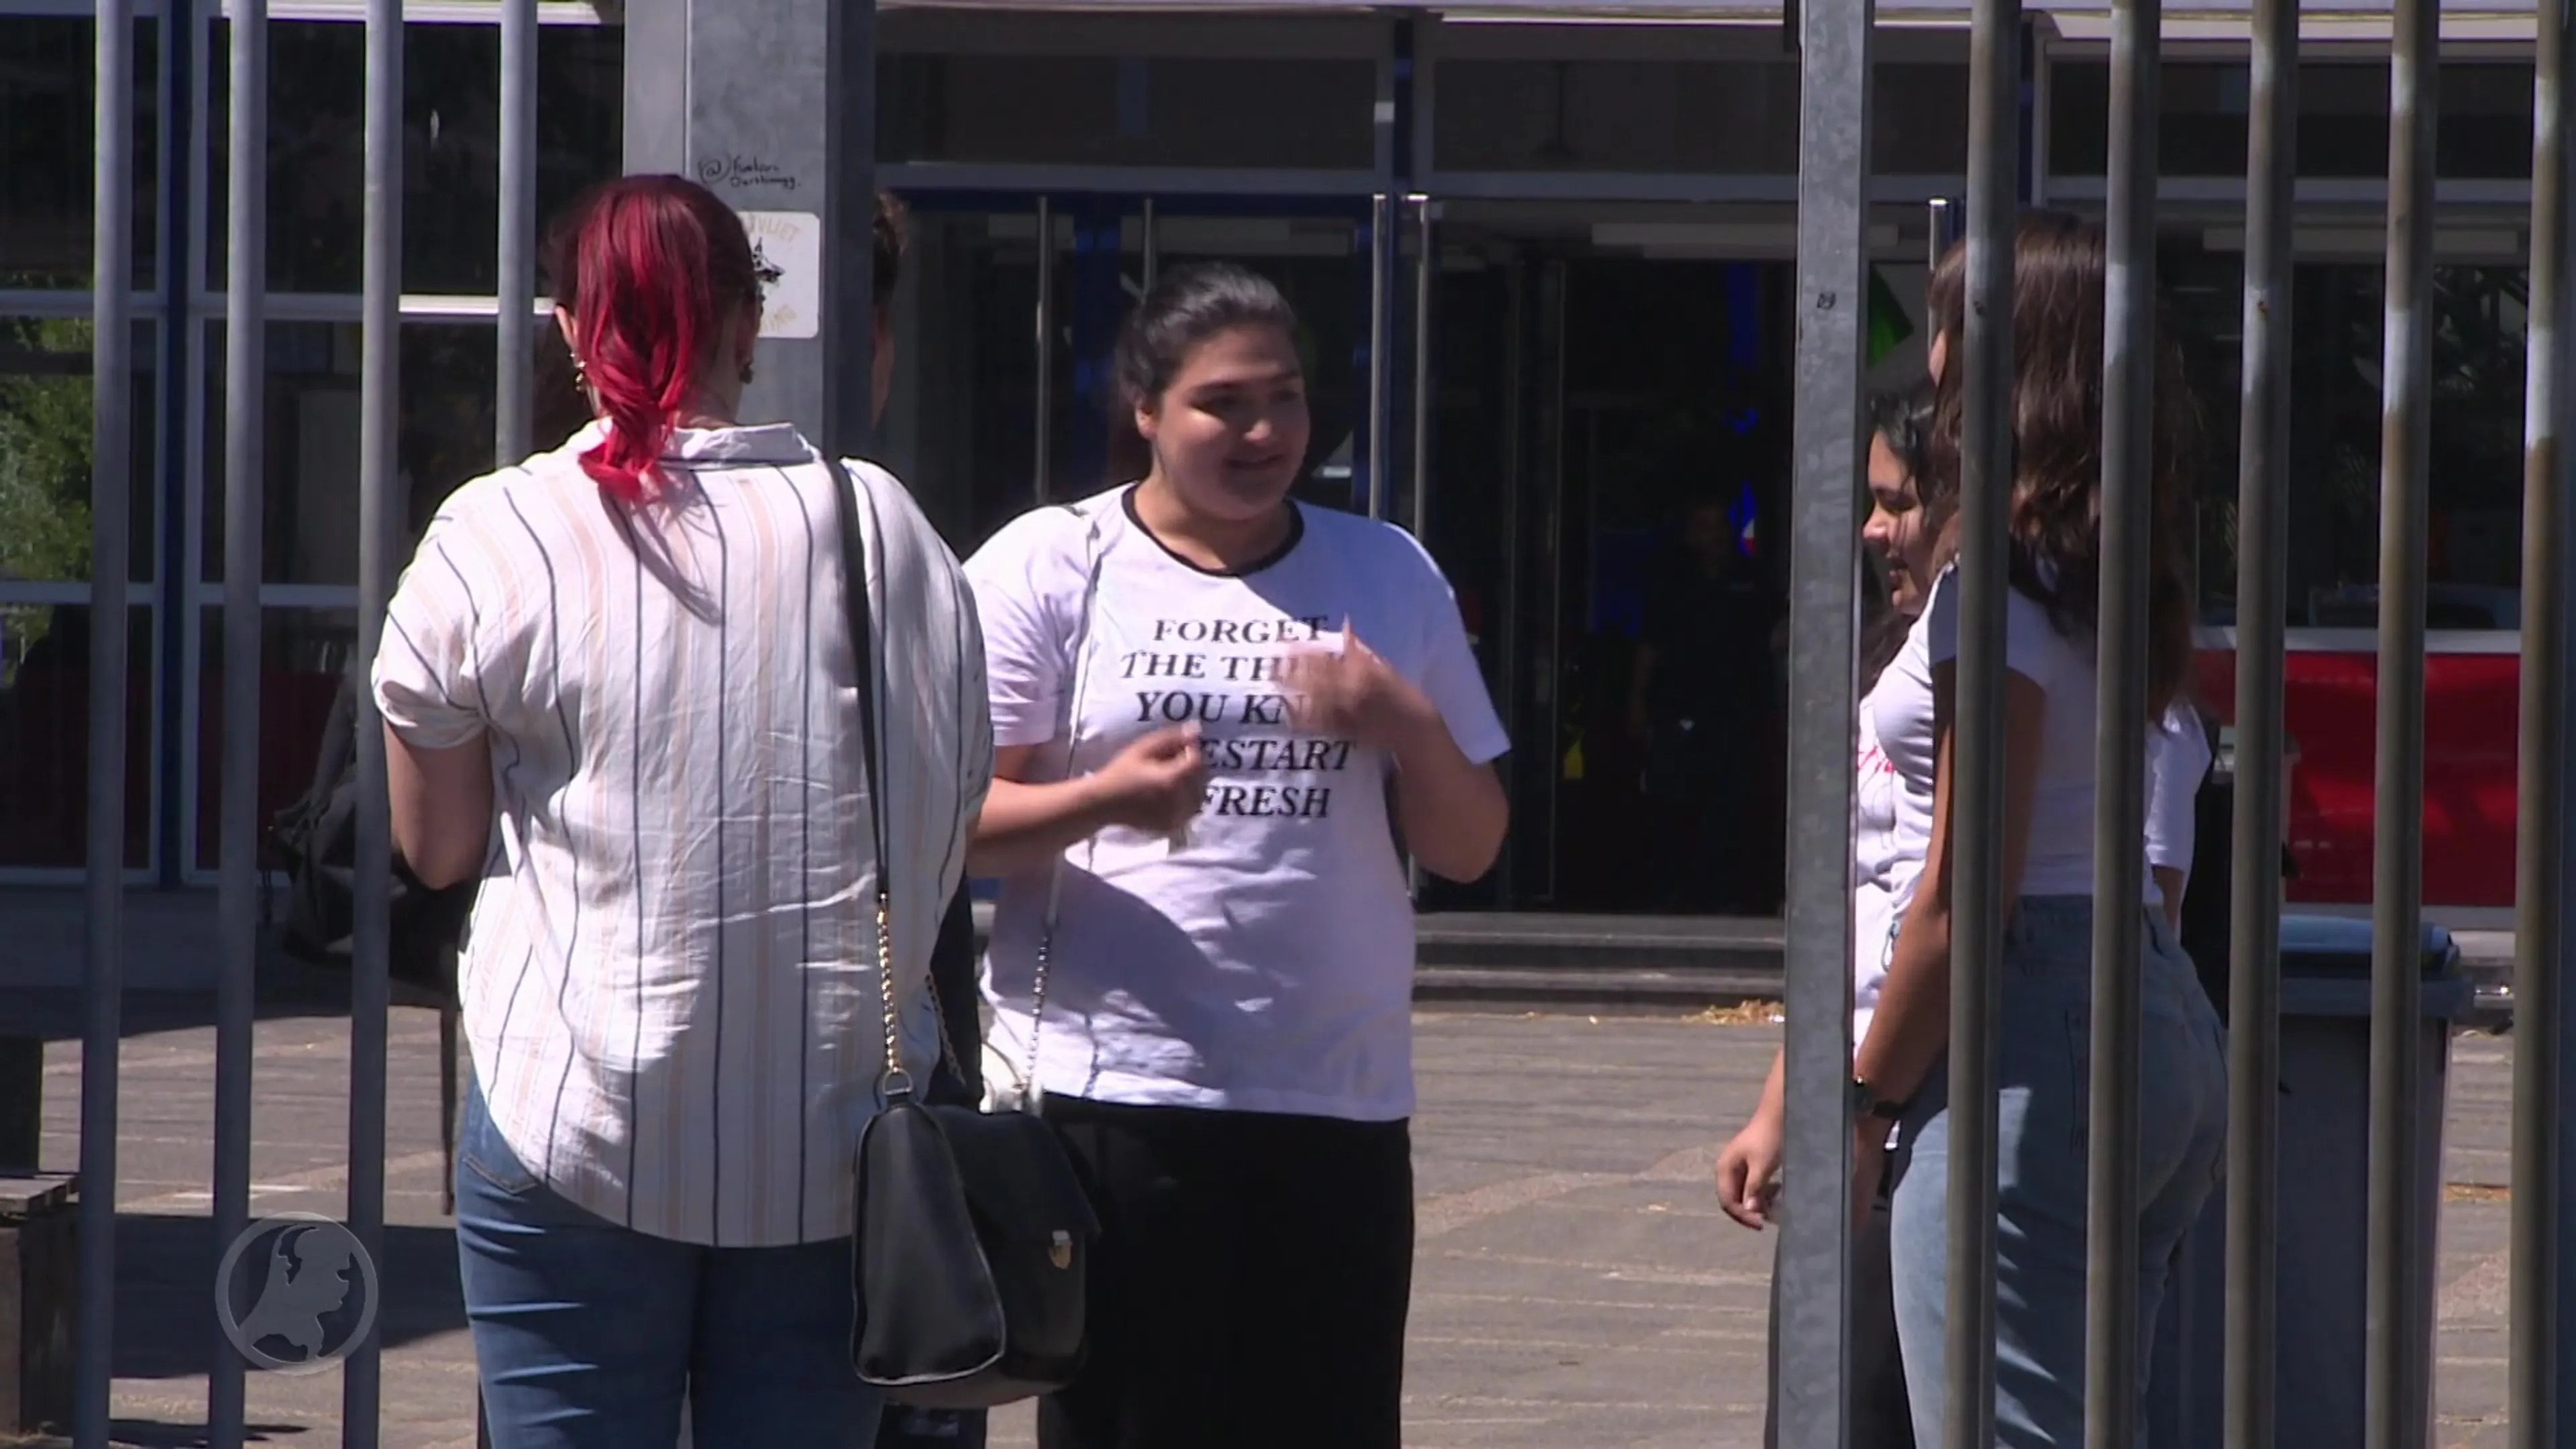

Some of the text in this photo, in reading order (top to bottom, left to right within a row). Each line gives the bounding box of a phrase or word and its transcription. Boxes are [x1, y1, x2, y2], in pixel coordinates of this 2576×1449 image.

[1152, 614, 1328, 644] FORGET
[1120, 649, 1207, 679] THE
[1136, 690, 1308, 724] YOU KN
[1199, 737, 1356, 771] ESTART
